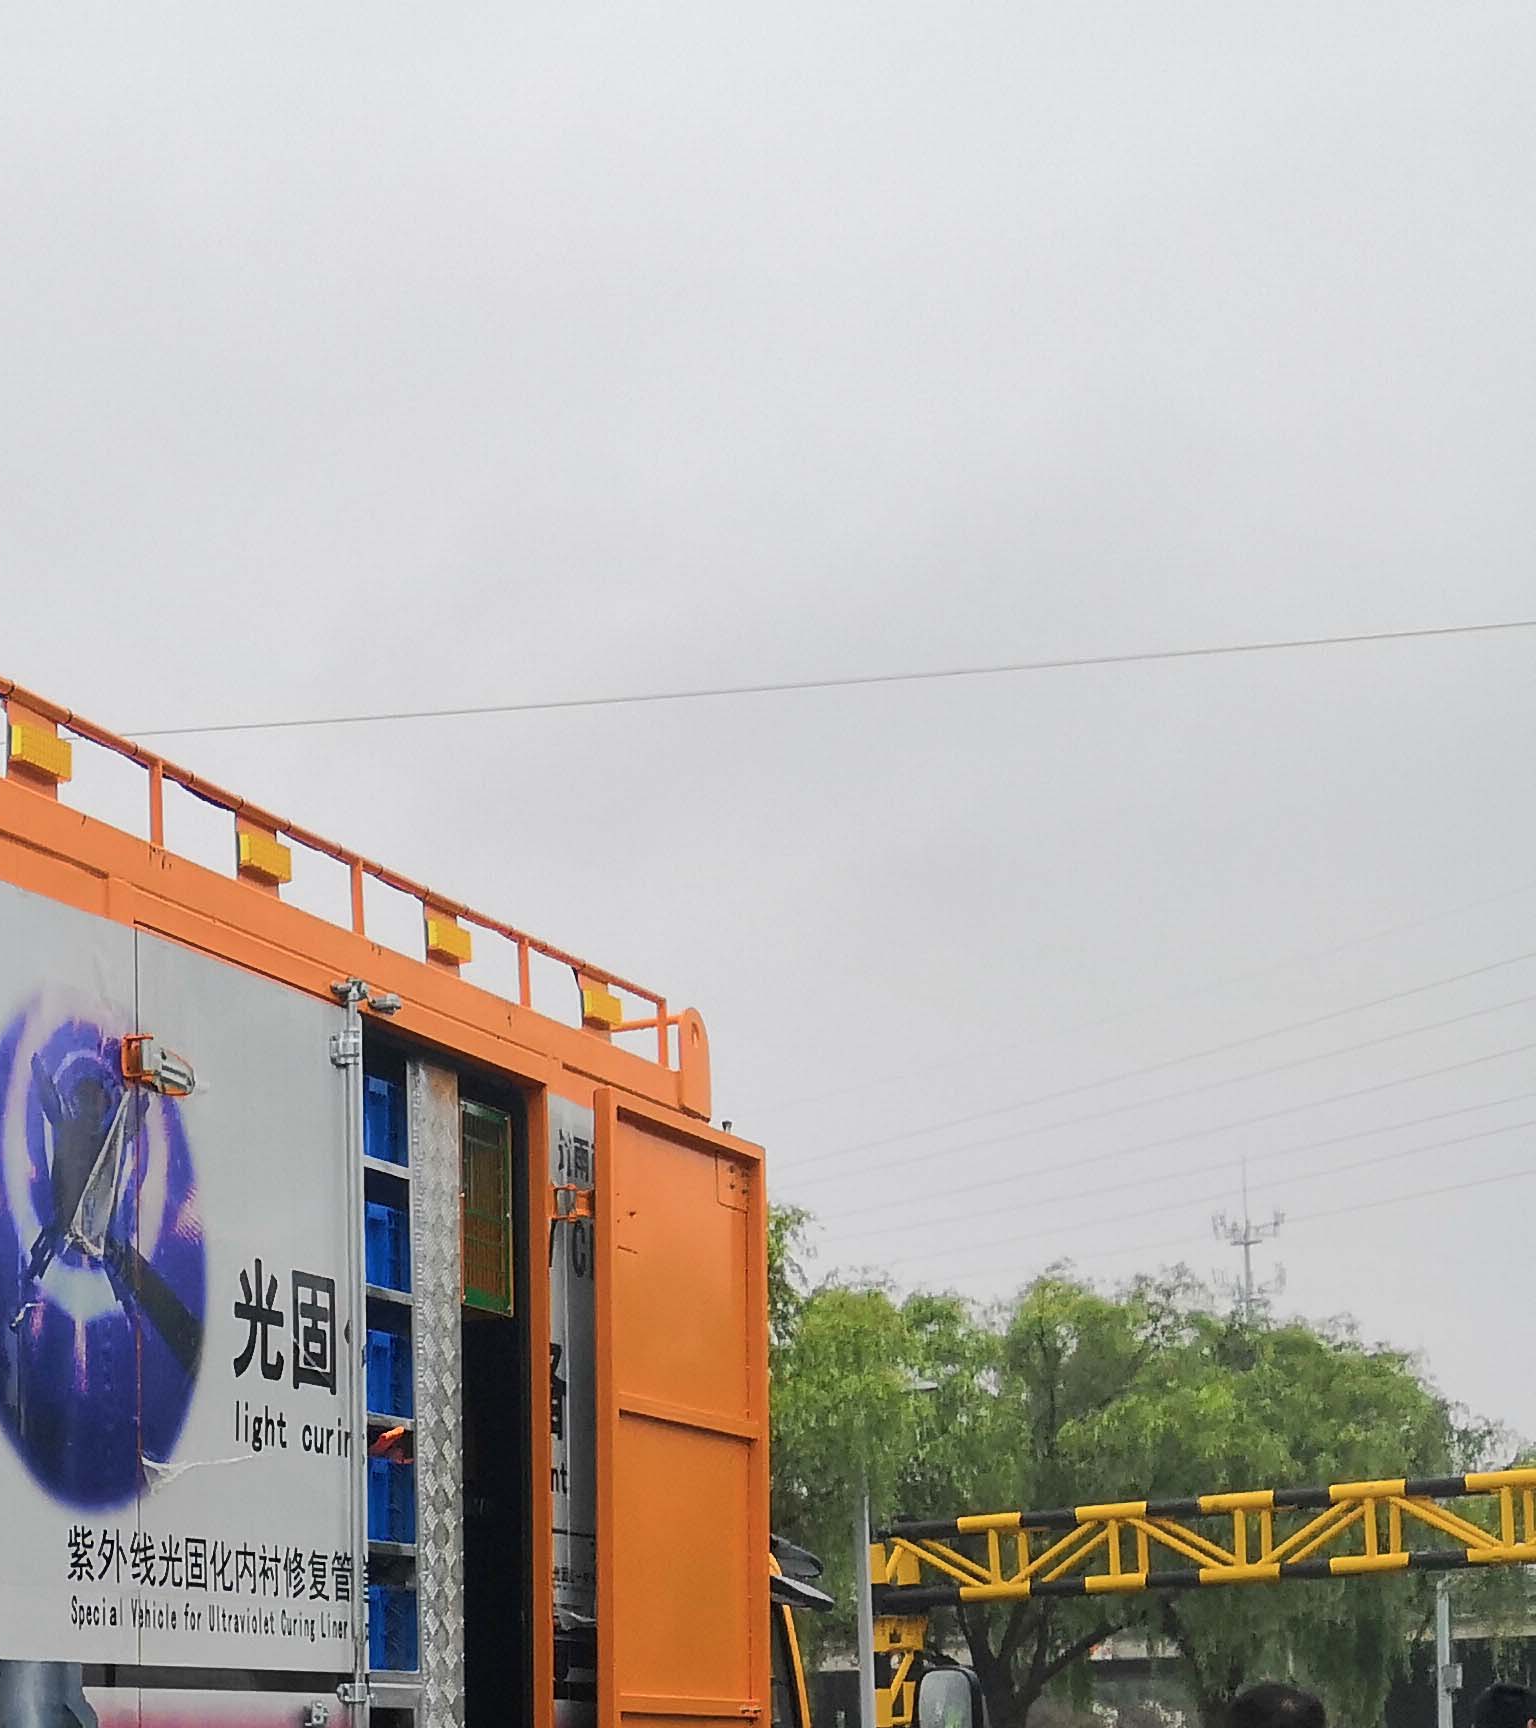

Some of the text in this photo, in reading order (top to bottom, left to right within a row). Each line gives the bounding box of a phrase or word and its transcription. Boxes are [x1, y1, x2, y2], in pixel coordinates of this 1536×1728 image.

[233, 1257, 365, 1396] 光固
[235, 1400, 365, 1465] light curin
[67, 1524, 370, 1603] 紫外线光固化内衬修复管
[71, 1595, 123, 1631] Special
[130, 1598, 177, 1630] Vehicle
[183, 1602, 202, 1631] for
[209, 1604, 275, 1636] Ultraviolet
[280, 1608, 315, 1643] Curing
[321, 1611, 348, 1640] Liner
